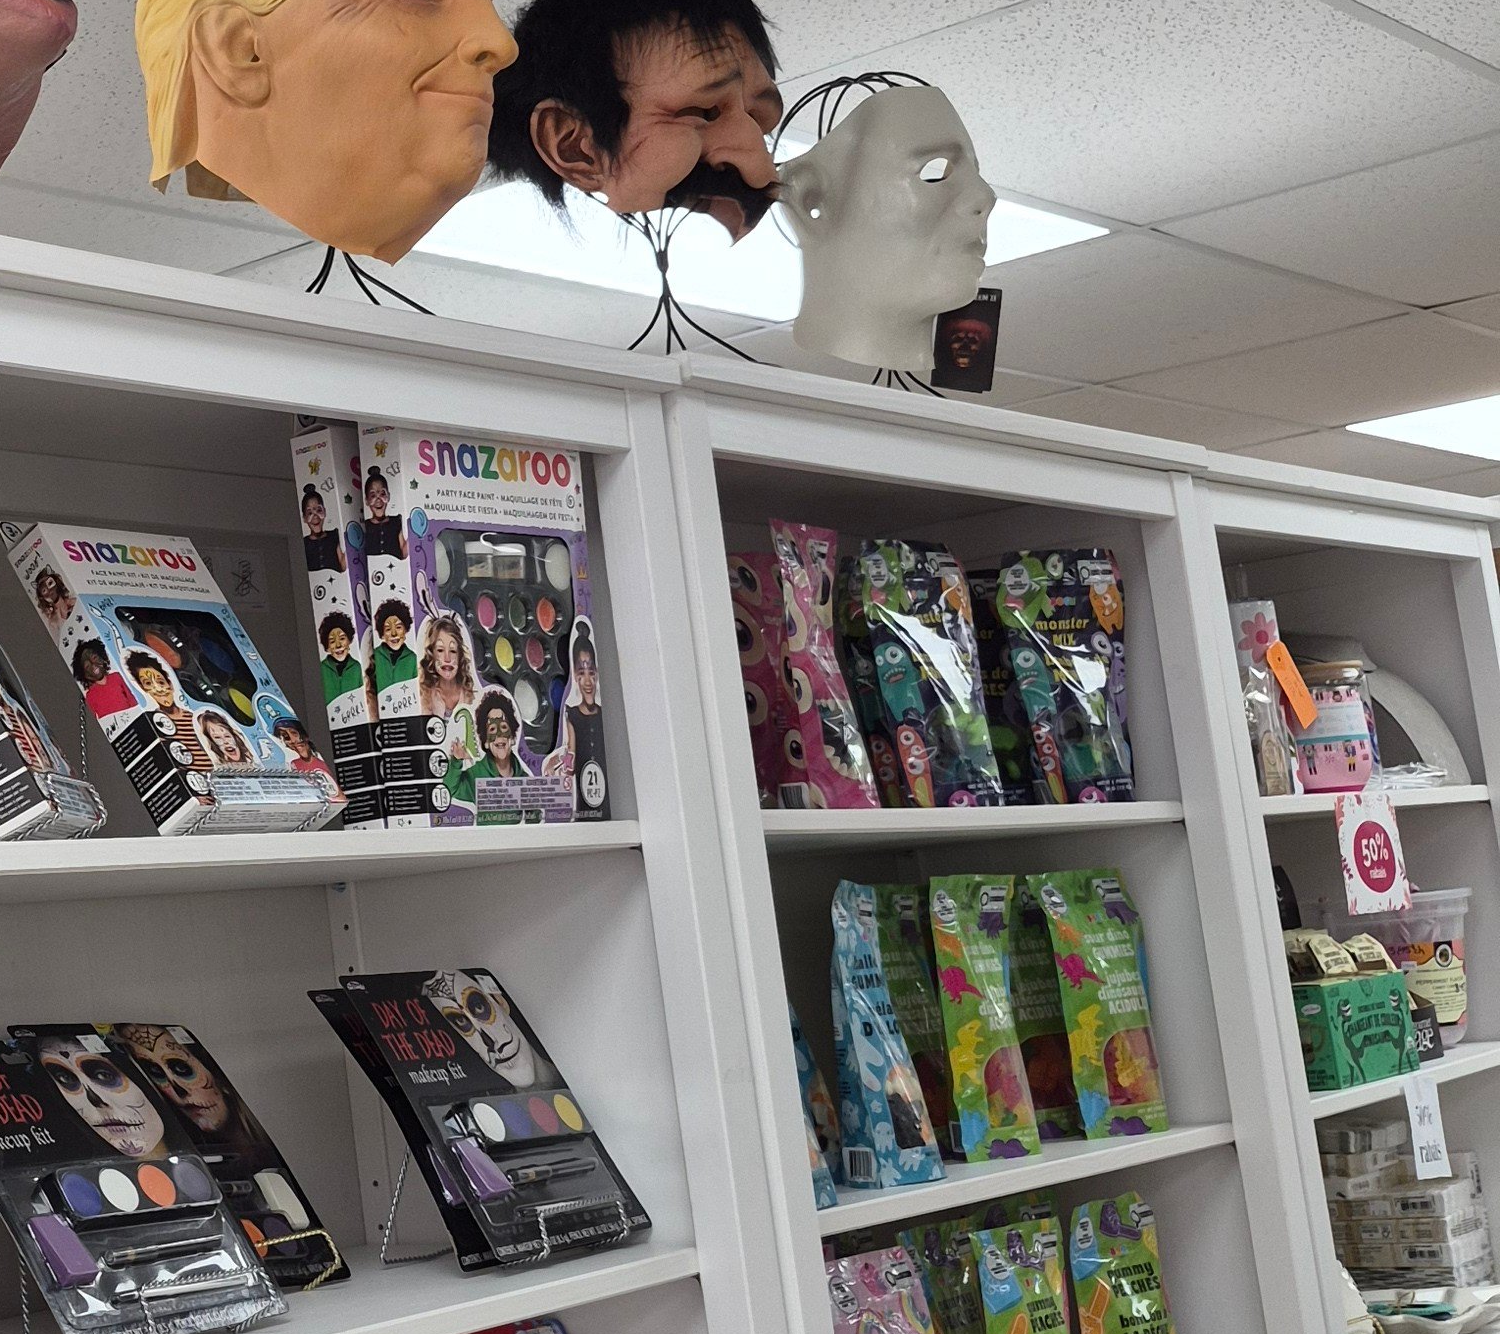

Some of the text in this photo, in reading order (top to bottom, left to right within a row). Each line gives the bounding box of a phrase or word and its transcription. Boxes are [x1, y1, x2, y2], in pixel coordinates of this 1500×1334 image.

[418, 439, 572, 488] snazaroo
[424, 502, 466, 515] MAQUILLAJE
[478, 505, 498, 516] FIESTA
[436, 488, 457, 499] PARTY
[459, 490, 476, 500] FACE
[477, 491, 495, 502] PAINT
[500, 494, 539, 507] MAQUILLAGE
[62, 538, 198, 572] snazaroo
[1035, 618, 1090, 631] monster
[587, 769, 599, 785] 21
[1361, 831, 1389, 868] 50%
[1107, 928, 1130, 942] dino
[371, 999, 409, 1029] DAY
[406, 998, 428, 1024] OF
[381, 1028, 456, 1062] THE DEAD
[409, 1061, 467, 1086] makeup kit
[34, 1122, 56, 1147] kit
